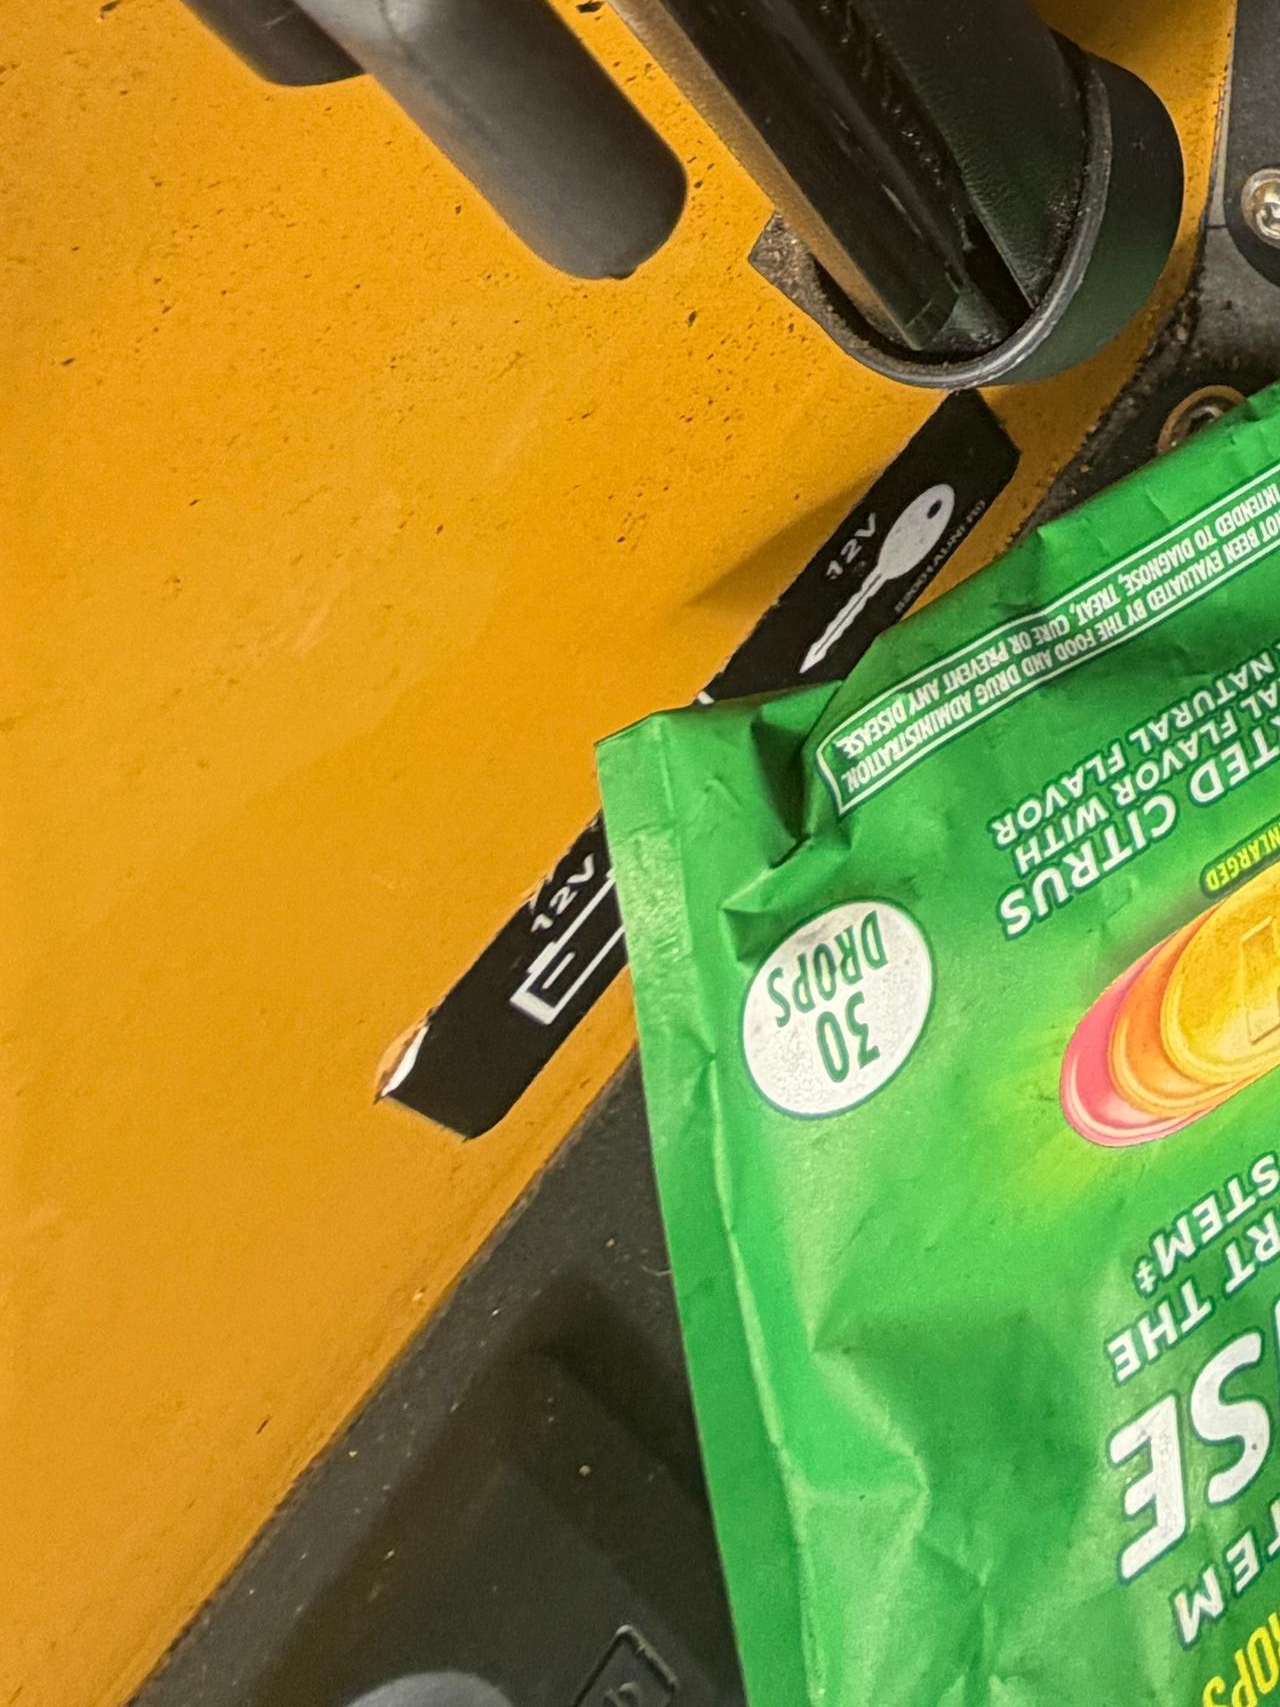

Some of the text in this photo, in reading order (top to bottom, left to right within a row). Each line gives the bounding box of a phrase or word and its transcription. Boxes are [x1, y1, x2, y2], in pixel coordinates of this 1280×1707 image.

[824, 510, 880, 583] 12V
[1194, 525, 1218, 551] TO
[1222, 527, 1260, 564] BEEN
[1117, 537, 1196, 596] DIAGNOSE,
[1146, 550, 1225, 611] EVALUATED
[1031, 614, 1071, 645] CURE
[1069, 584, 1121, 626] TREAT,
[1094, 611, 1127, 642] THE
[1125, 598, 1148, 626] BY
[942, 641, 1010, 695] PREVENT
[1007, 631, 1032, 655] OR
[1021, 649, 1053, 677] AND
[1054, 628, 1097, 661] FOOD
[907, 679, 940, 716] ANY
[974, 664, 1022, 705] DRUG
[1129, 652, 1275, 753] NATURAL
[1111, 710, 1238, 806] FLAVOR
[991, 743, 1125, 845] FLAVOR
[1015, 797, 1109, 874] WITH
[530, 851, 595, 934] 12V
[1000, 794, 1176, 935] CITRUS
[766, 910, 888, 1027] DROPS
[813, 991, 882, 1084] 30
[1107, 1282, 1211, 1382] THE
